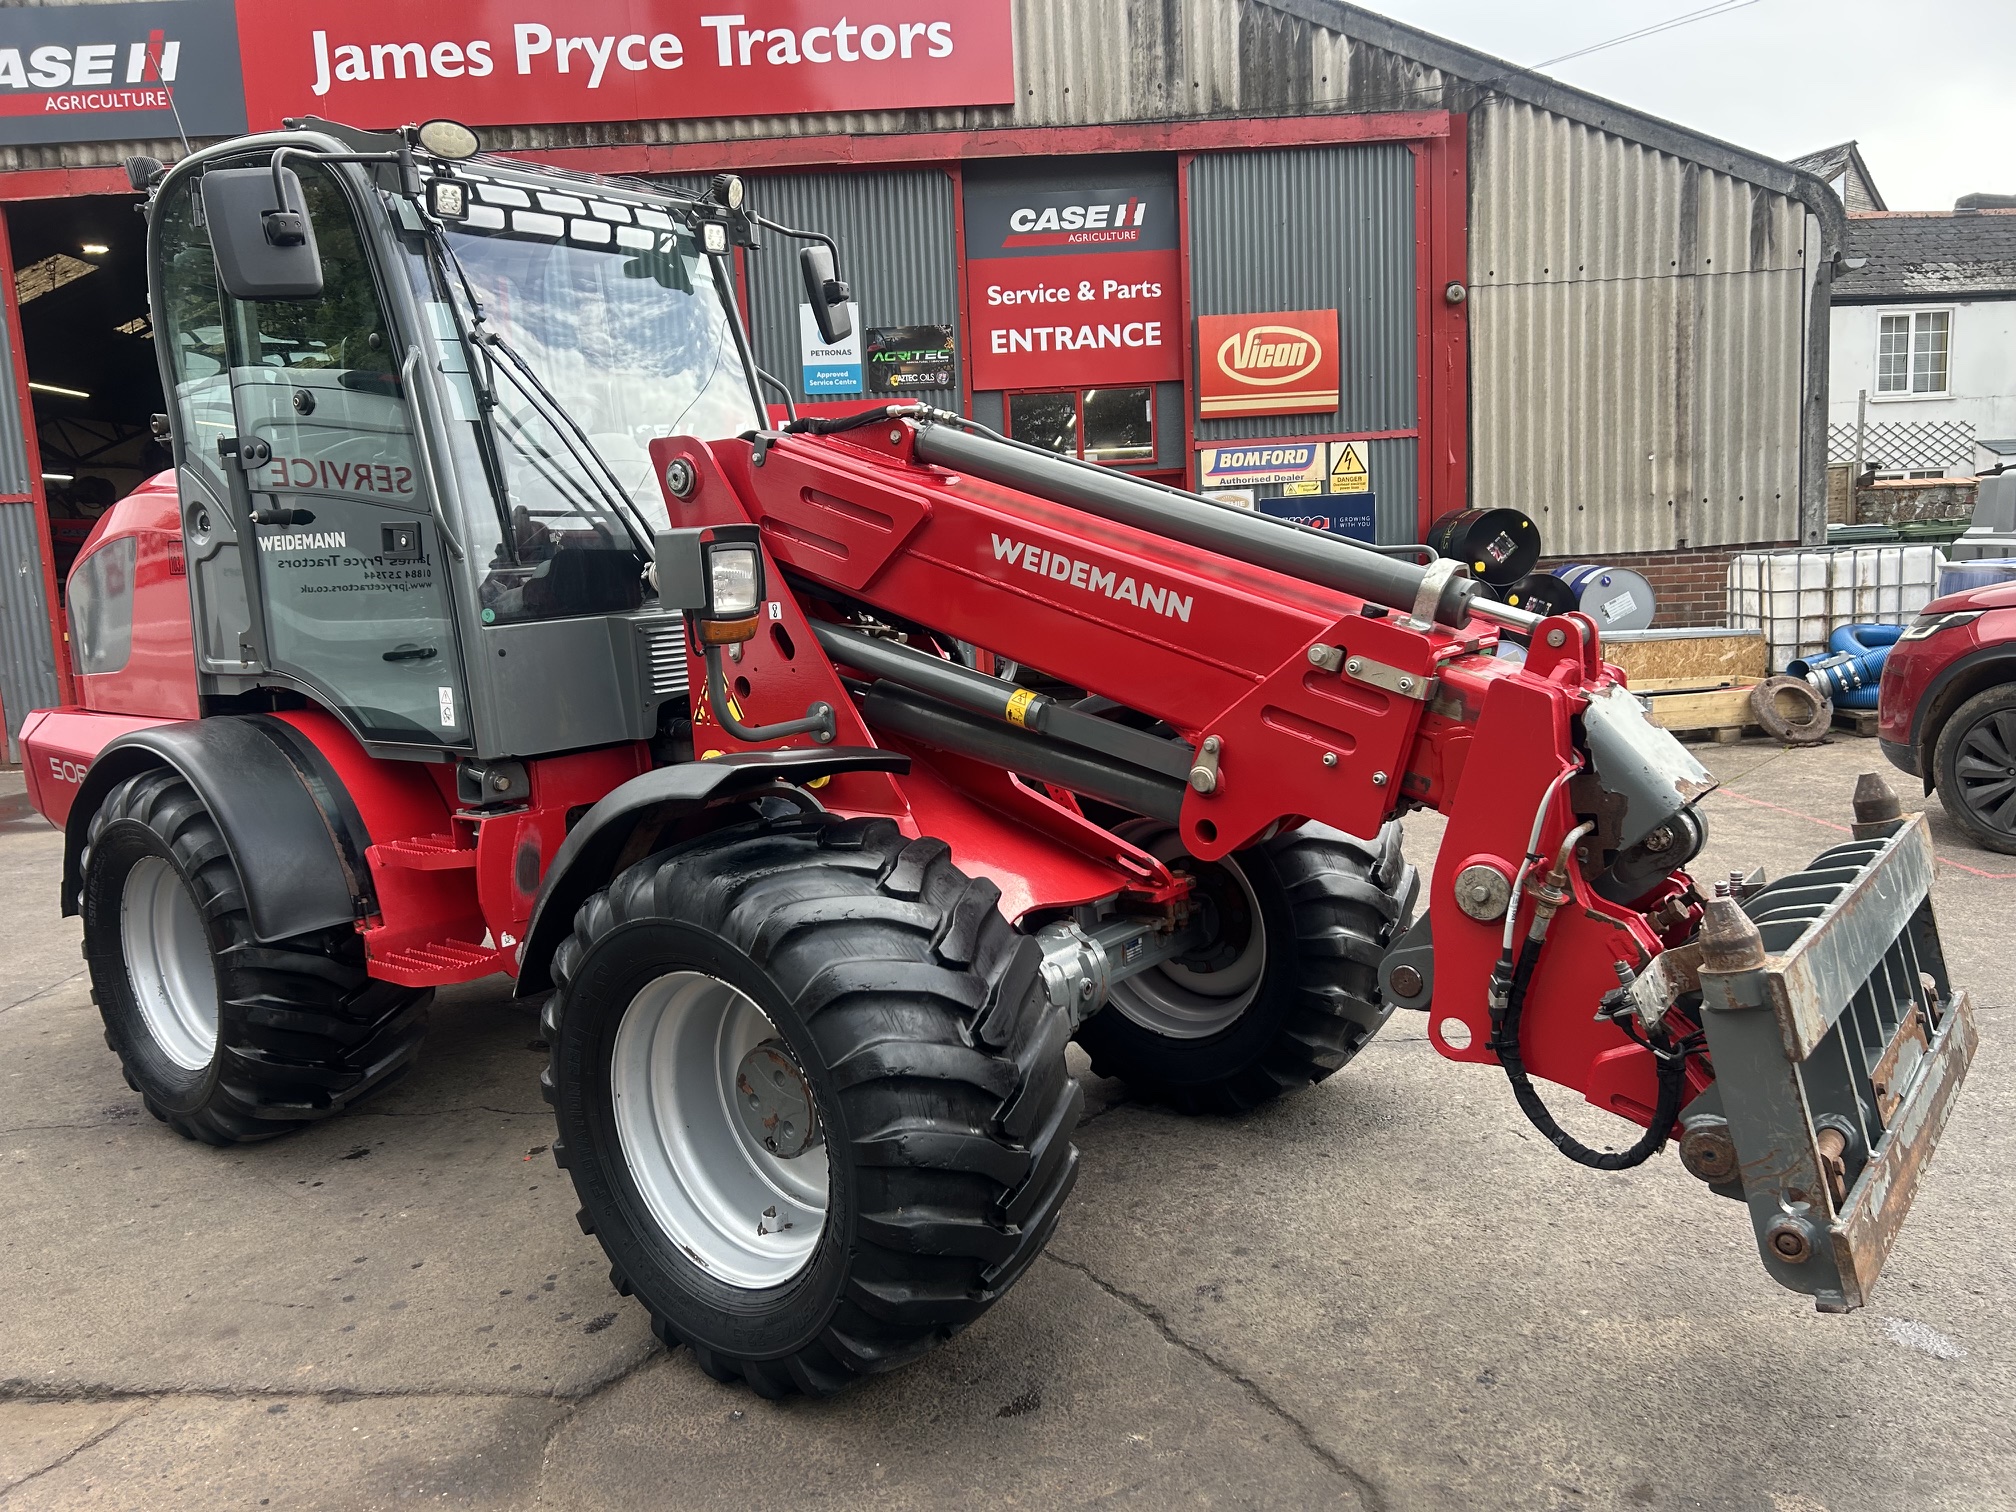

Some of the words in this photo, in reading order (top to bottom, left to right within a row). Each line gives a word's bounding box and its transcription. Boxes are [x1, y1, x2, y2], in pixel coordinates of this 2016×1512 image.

[310, 30, 495, 96] James
[513, 23, 684, 89] Pryce
[700, 14, 955, 68] Tractors
[45, 91, 167, 111] AGRICULTURE
[1009, 204, 1111, 232] CASE
[1068, 230, 1136, 243] AGRICULTURE
[987, 283, 1071, 306] Service
[1077, 280, 1096, 301] &
[1103, 279, 1162, 300] Parts
[990, 321, 1162, 354] ENTRANCE
[810, 349, 852, 357] PETRONAS
[872, 350, 950, 362] AGRITEC
[816, 371, 849, 380] Approved
[919, 373, 935, 382] OILS
[1219, 449, 1309, 468] BOMFORD
[1219, 475, 1271, 485] Authorised
[1274, 473, 1305, 483] Dealer
[258, 531, 347, 552] WEIDEMANN
[991, 532, 1194, 623] WEIDEMANN
